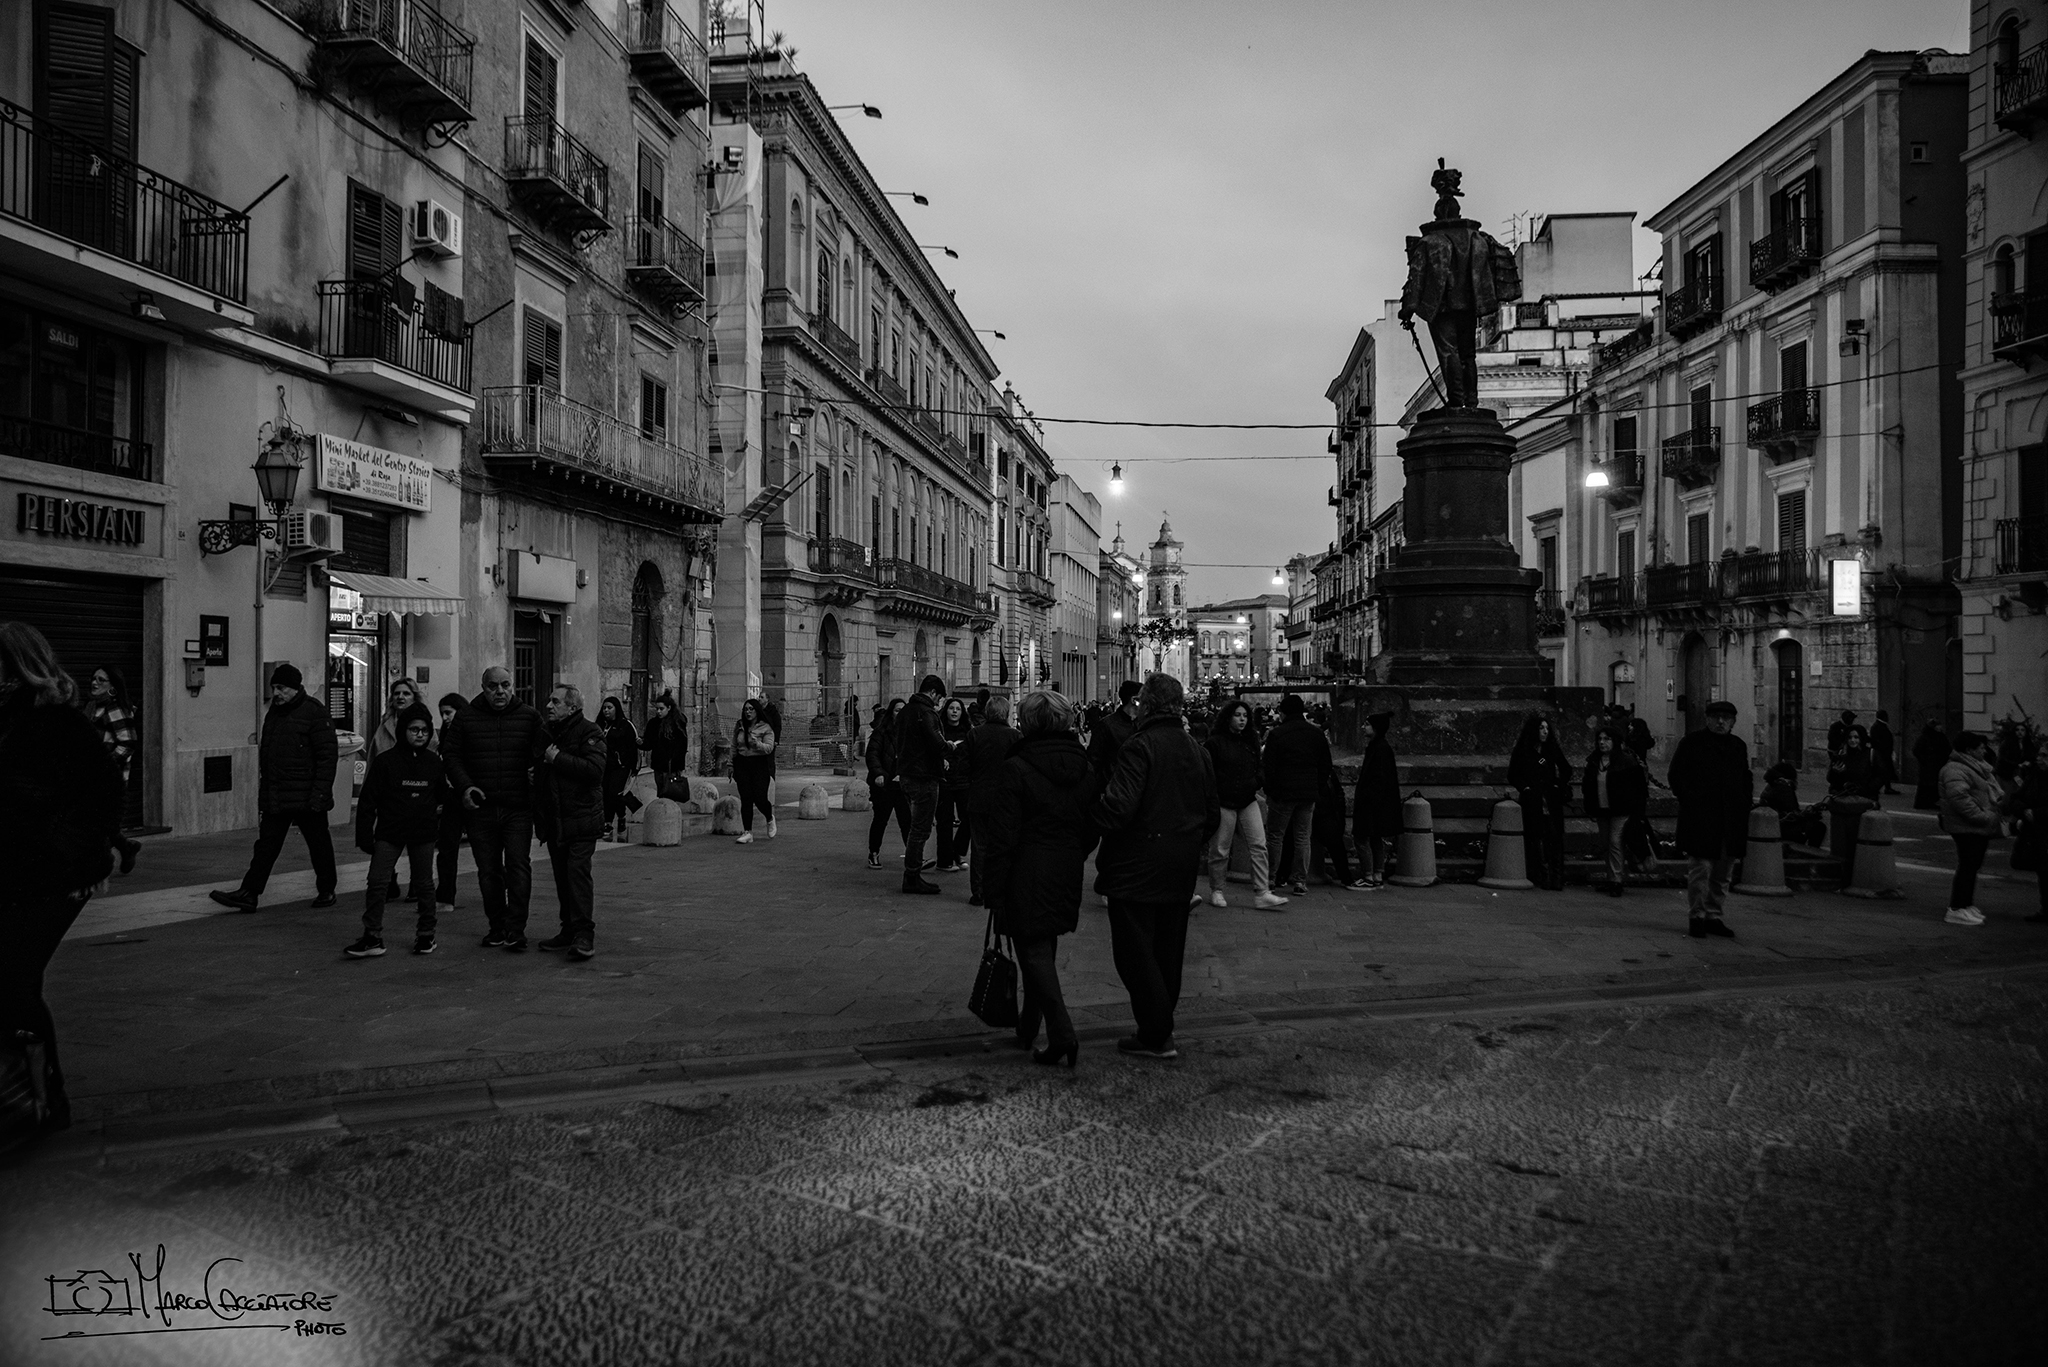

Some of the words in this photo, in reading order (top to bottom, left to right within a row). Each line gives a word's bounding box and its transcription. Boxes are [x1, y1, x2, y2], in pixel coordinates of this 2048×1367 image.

[48, 328, 79, 349] SALDI
[325, 438, 342, 456] Mini
[344, 443, 370, 463] Market
[372, 452, 383, 468] del
[384, 454, 407, 473] Centro
[18, 493, 146, 544] PERSIANI
[330, 613, 351, 622] APERTO
